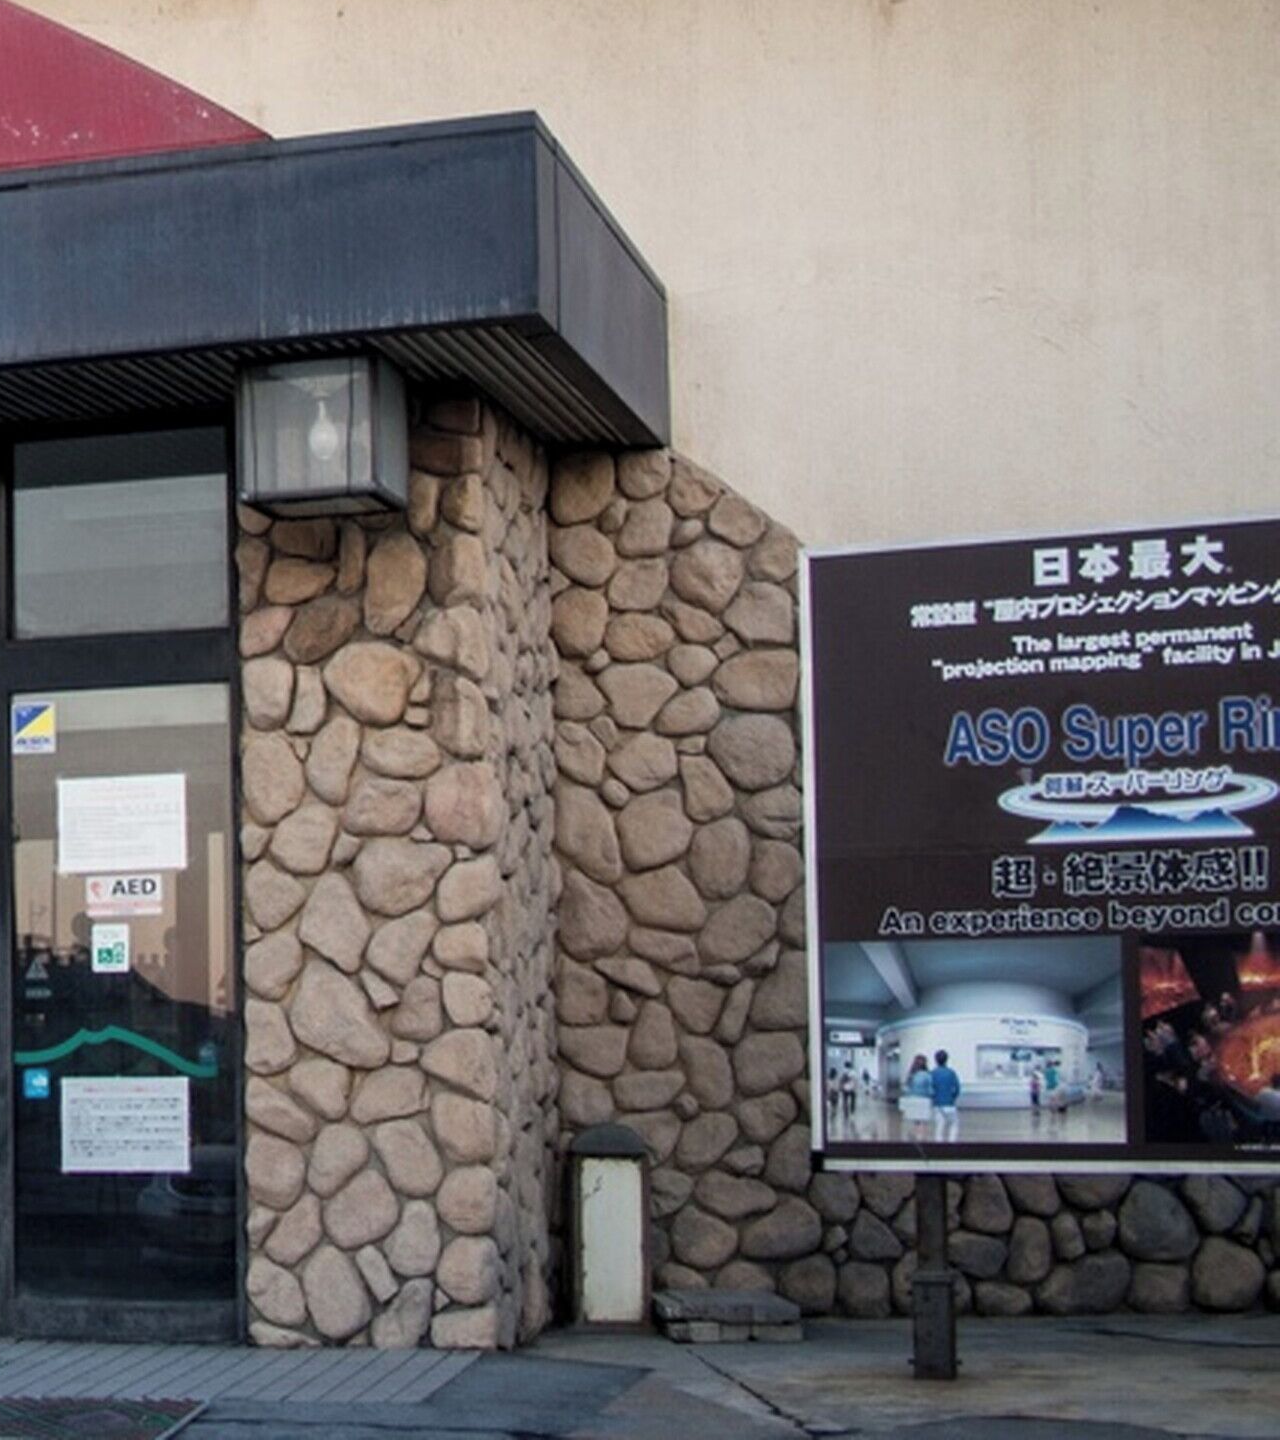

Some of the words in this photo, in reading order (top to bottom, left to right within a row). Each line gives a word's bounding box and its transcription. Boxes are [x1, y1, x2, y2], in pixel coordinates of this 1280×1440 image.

[1012, 635, 1052, 655] The
[1057, 630, 1130, 655] largest
[1136, 622, 1253, 649] permanent
[1162, 644, 1235, 664] facility
[1241, 642, 1262, 660] in
[944, 707, 1050, 766] ASO
[1063, 704, 1208, 769] Super
[112, 878, 157, 896] AED
[879, 906, 924, 935] An
[930, 903, 1101, 936] experience
[1108, 897, 1229, 934] beyond
[1234, 901, 1280, 927] co
